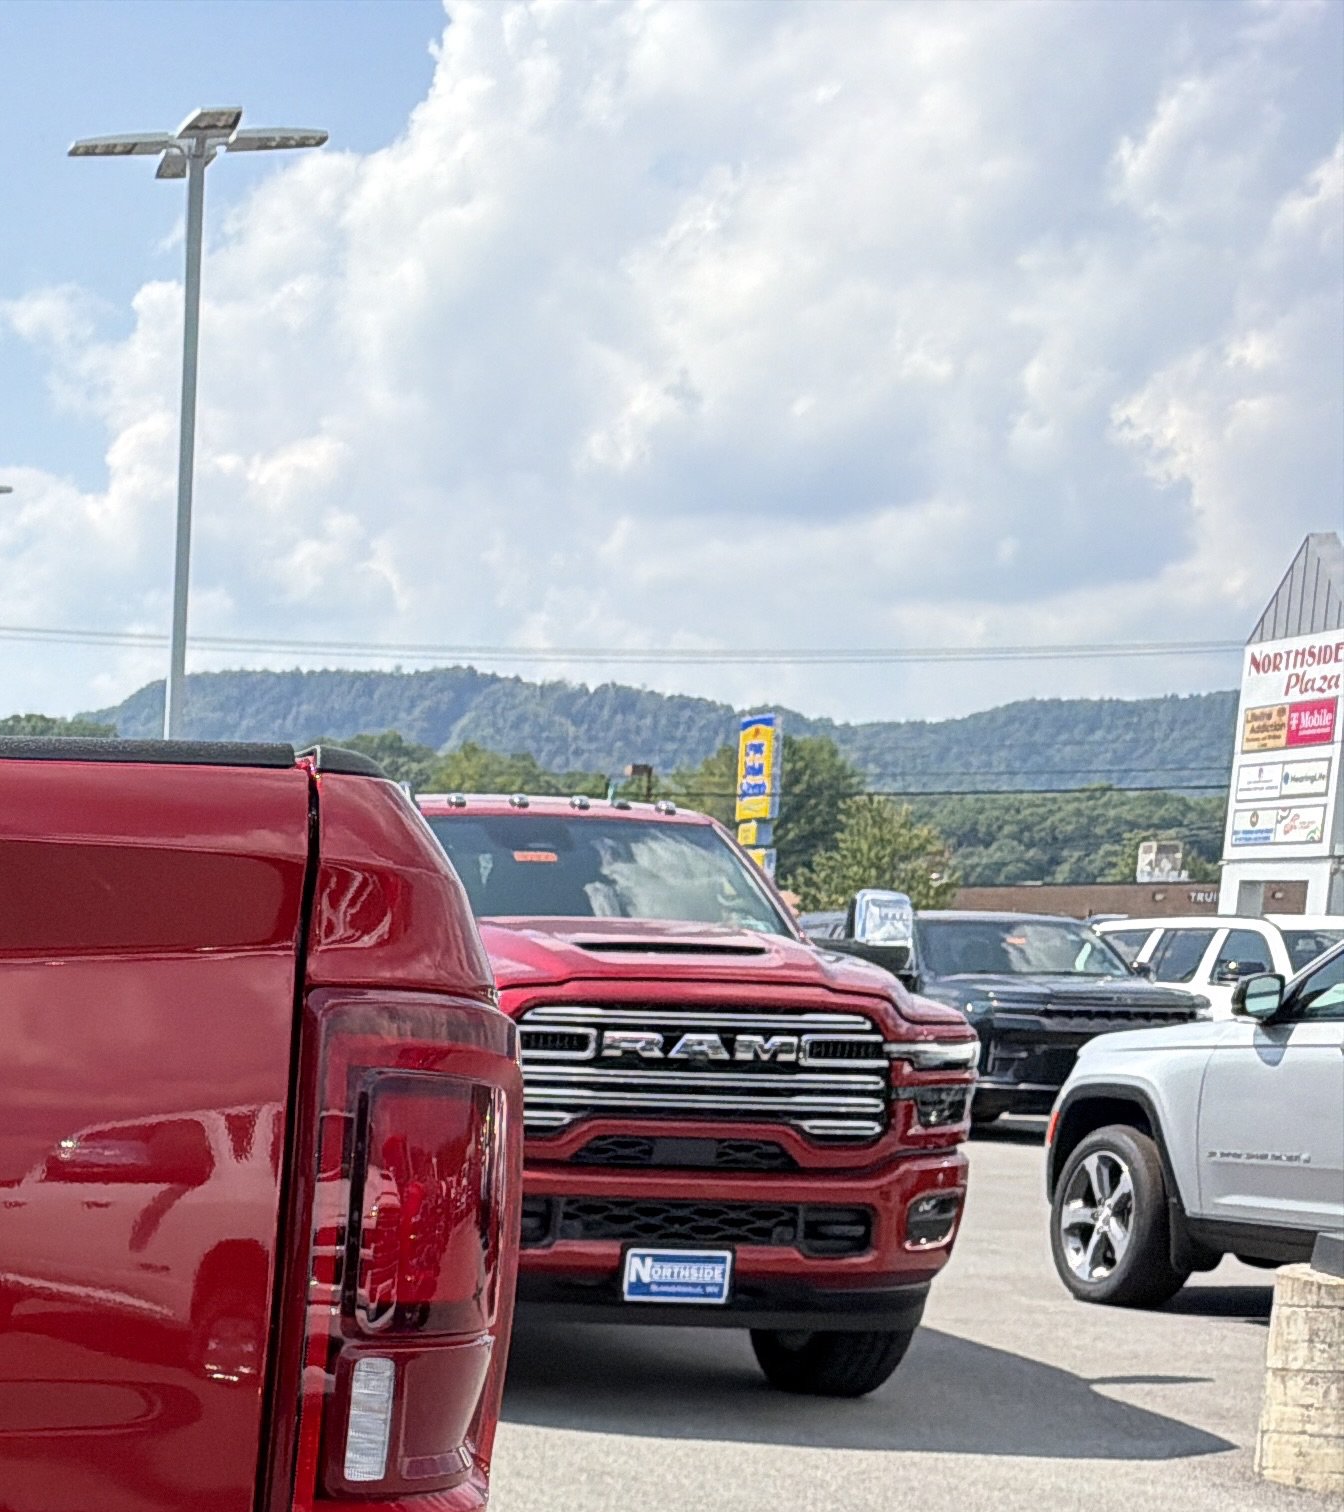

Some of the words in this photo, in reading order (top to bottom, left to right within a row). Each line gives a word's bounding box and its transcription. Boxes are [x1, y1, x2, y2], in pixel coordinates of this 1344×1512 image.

[1248, 641, 1344, 677] NORTHSIDE
[1284, 669, 1341, 697] Plaza
[602, 1030, 800, 1063] RAM
[629, 1256, 724, 1283] NORTHSIDE
